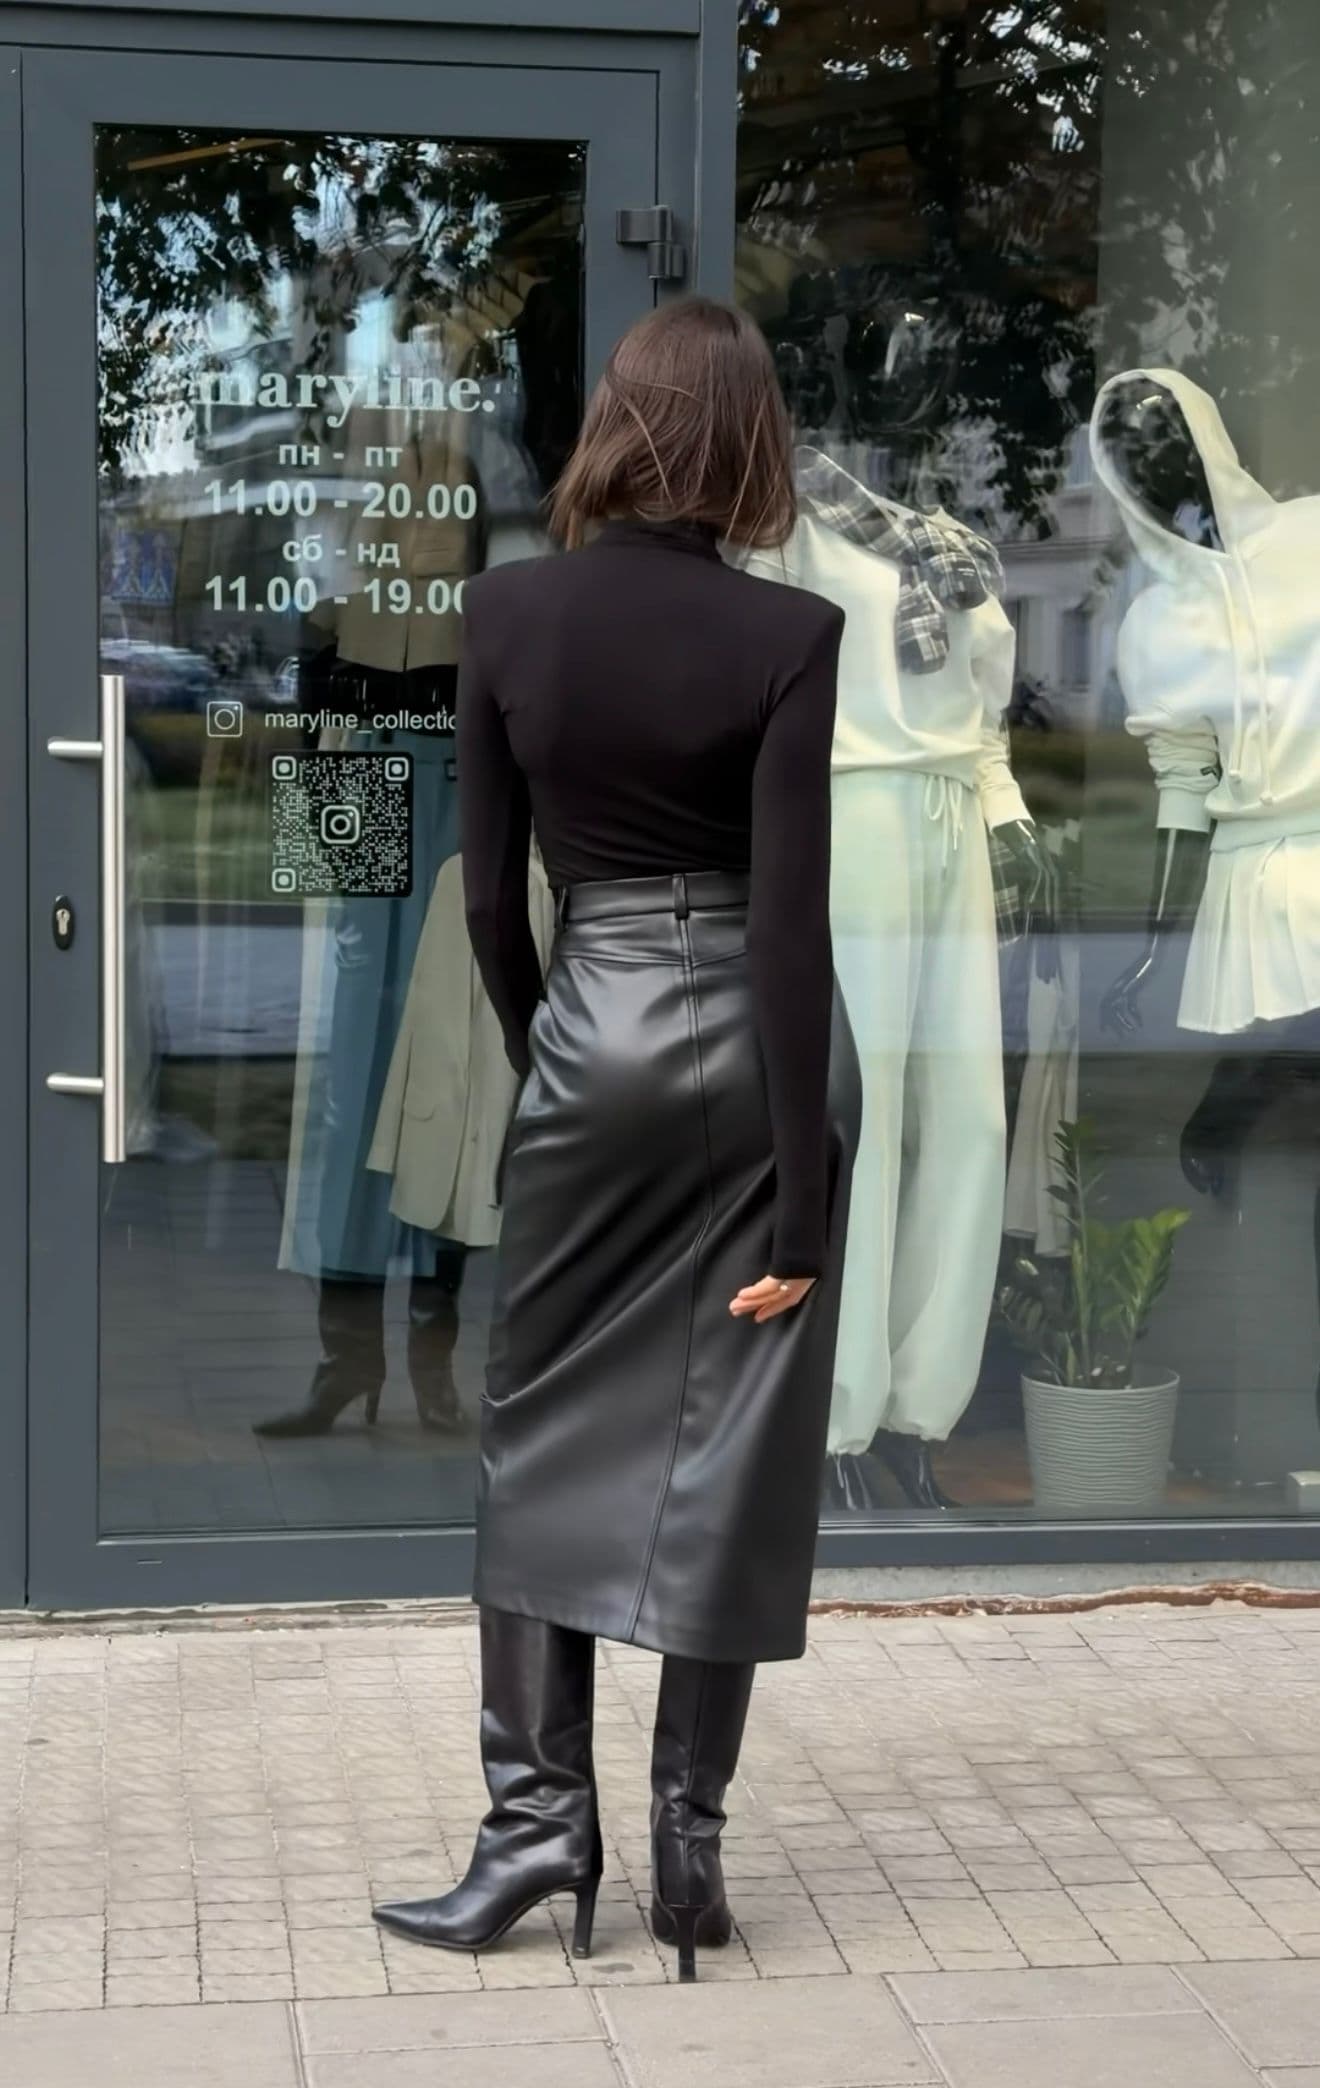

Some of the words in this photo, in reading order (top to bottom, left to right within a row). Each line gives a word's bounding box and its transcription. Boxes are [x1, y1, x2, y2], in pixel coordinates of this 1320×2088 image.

[190, 366, 496, 428] maryline.
[279, 444, 320, 466] пн
[365, 446, 403, 467] пт
[204, 479, 317, 516] 11.00
[361, 482, 478, 520] 20.00
[282, 536, 322, 562] сб
[357, 542, 401, 568] нд
[204, 575, 317, 612] 11.00
